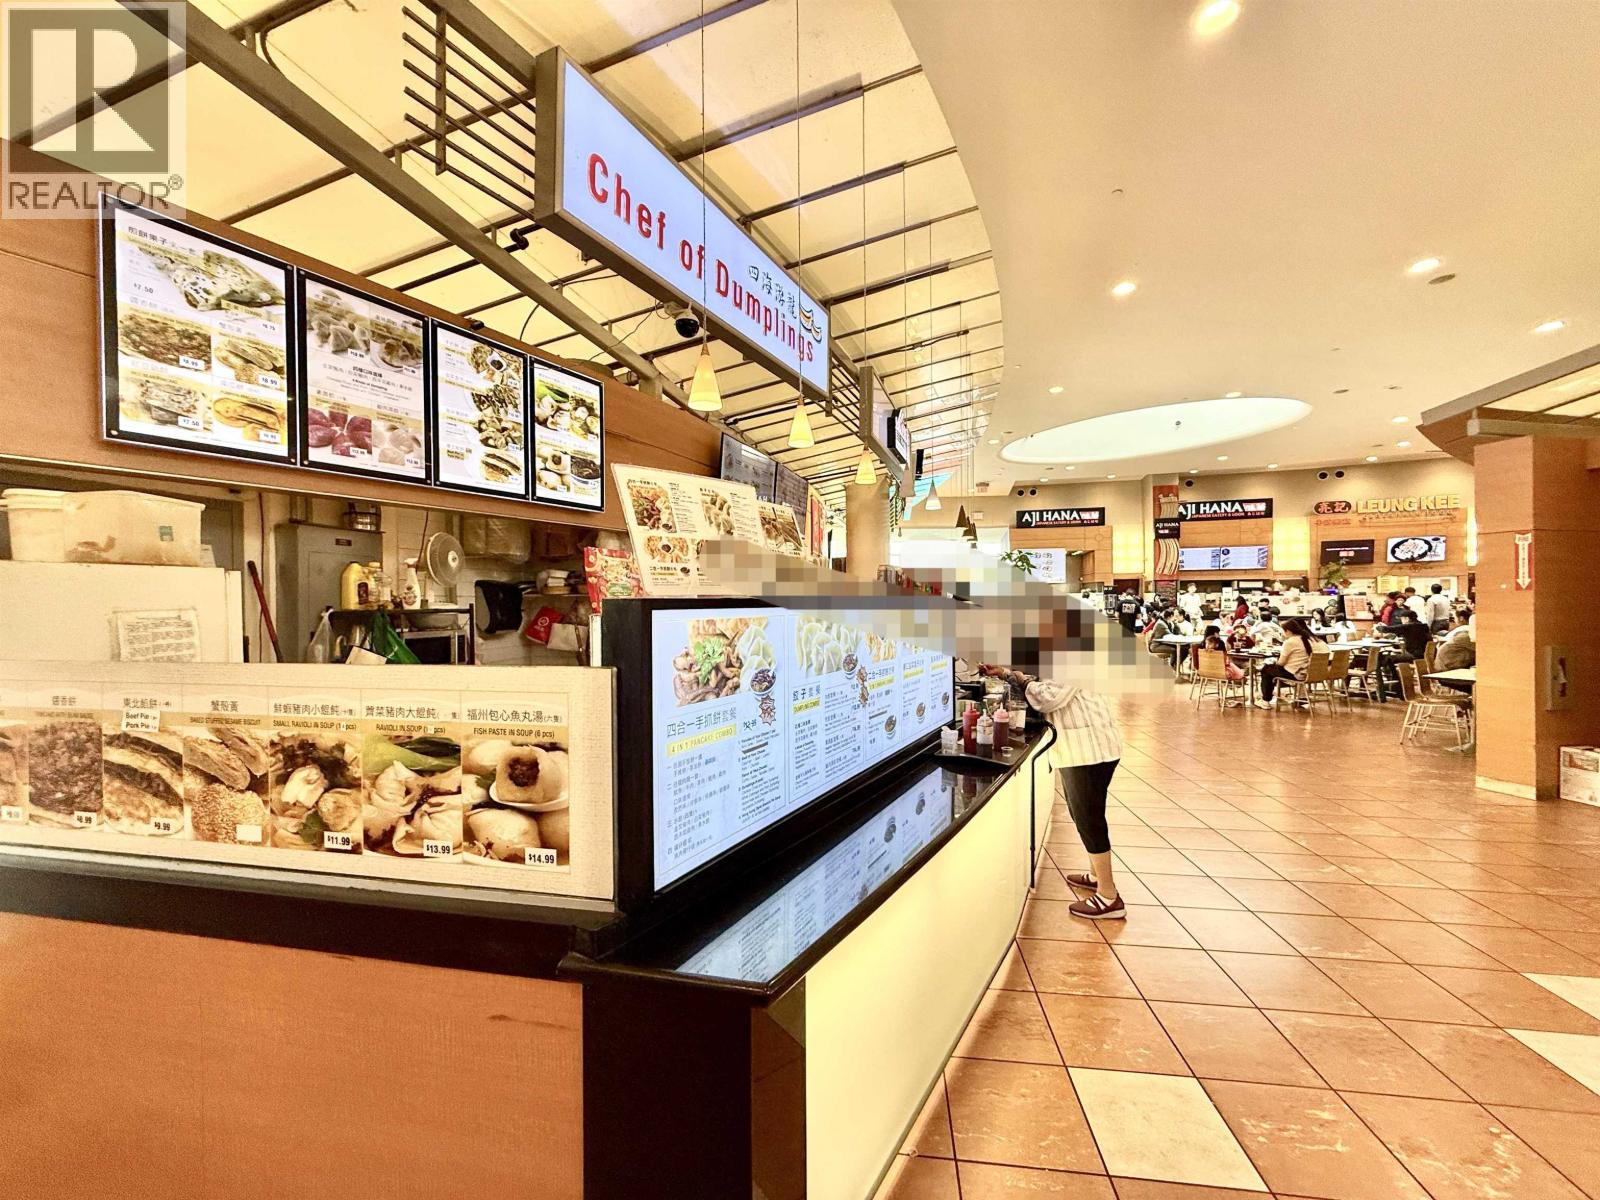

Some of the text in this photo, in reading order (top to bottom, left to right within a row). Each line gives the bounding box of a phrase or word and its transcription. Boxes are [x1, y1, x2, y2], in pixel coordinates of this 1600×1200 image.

[586, 152, 813, 363] Chef of Dumplings
[1356, 494, 1461, 514] LEUNG KEE
[1178, 503, 1196, 520] AJI
[1200, 501, 1243, 514] HANA
[1021, 511, 1040, 527] AJI
[1043, 510, 1080, 522] HANA
[273, 719, 290, 727] SMALL
[291, 720, 312, 728] RAVIOLI
[320, 721, 335, 729] SOUP
[376, 723, 398, 731] RAVIOLI
[399, 724, 405, 732] IN
[406, 724, 423, 733] SOUP
[473, 727, 488, 735] FISH
[488, 728, 507, 736] PASTE
[516, 729, 534, 737] SOUP
[542, 731, 555, 739] pcs)
[326, 835, 351, 847] $11.99
[426, 844, 451, 855] $13.99
[528, 853, 555, 865] $14.99
